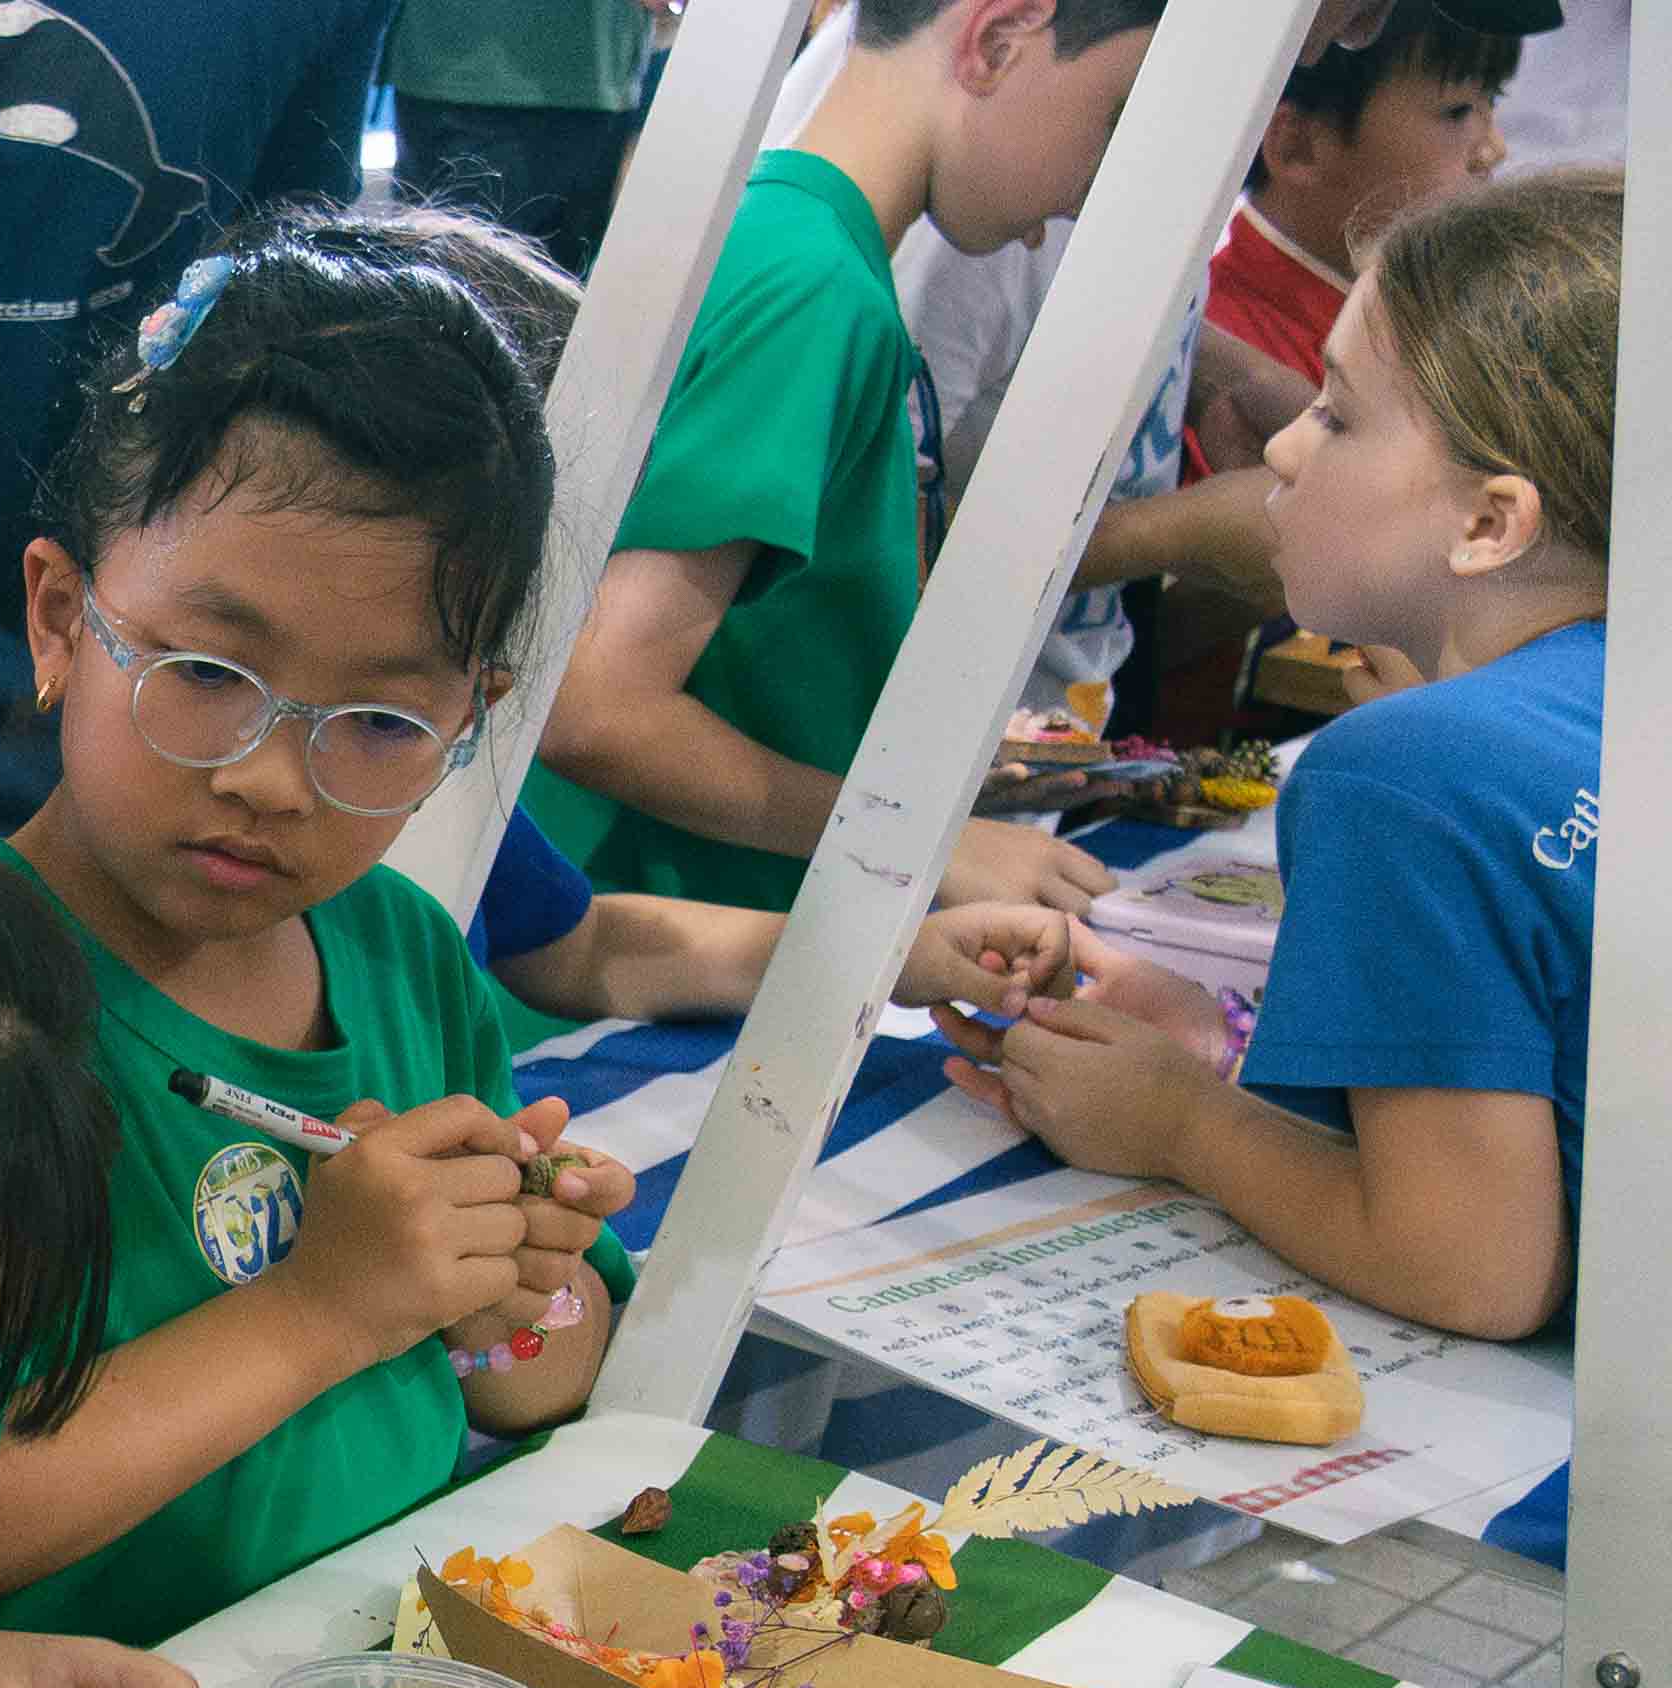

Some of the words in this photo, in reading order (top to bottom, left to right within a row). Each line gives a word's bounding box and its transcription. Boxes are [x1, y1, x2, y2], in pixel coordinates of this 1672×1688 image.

[265, 1102, 297, 1122] PEN
[826, 1257, 1005, 1315] Cantonese
[997, 1197, 1201, 1271] introduction
